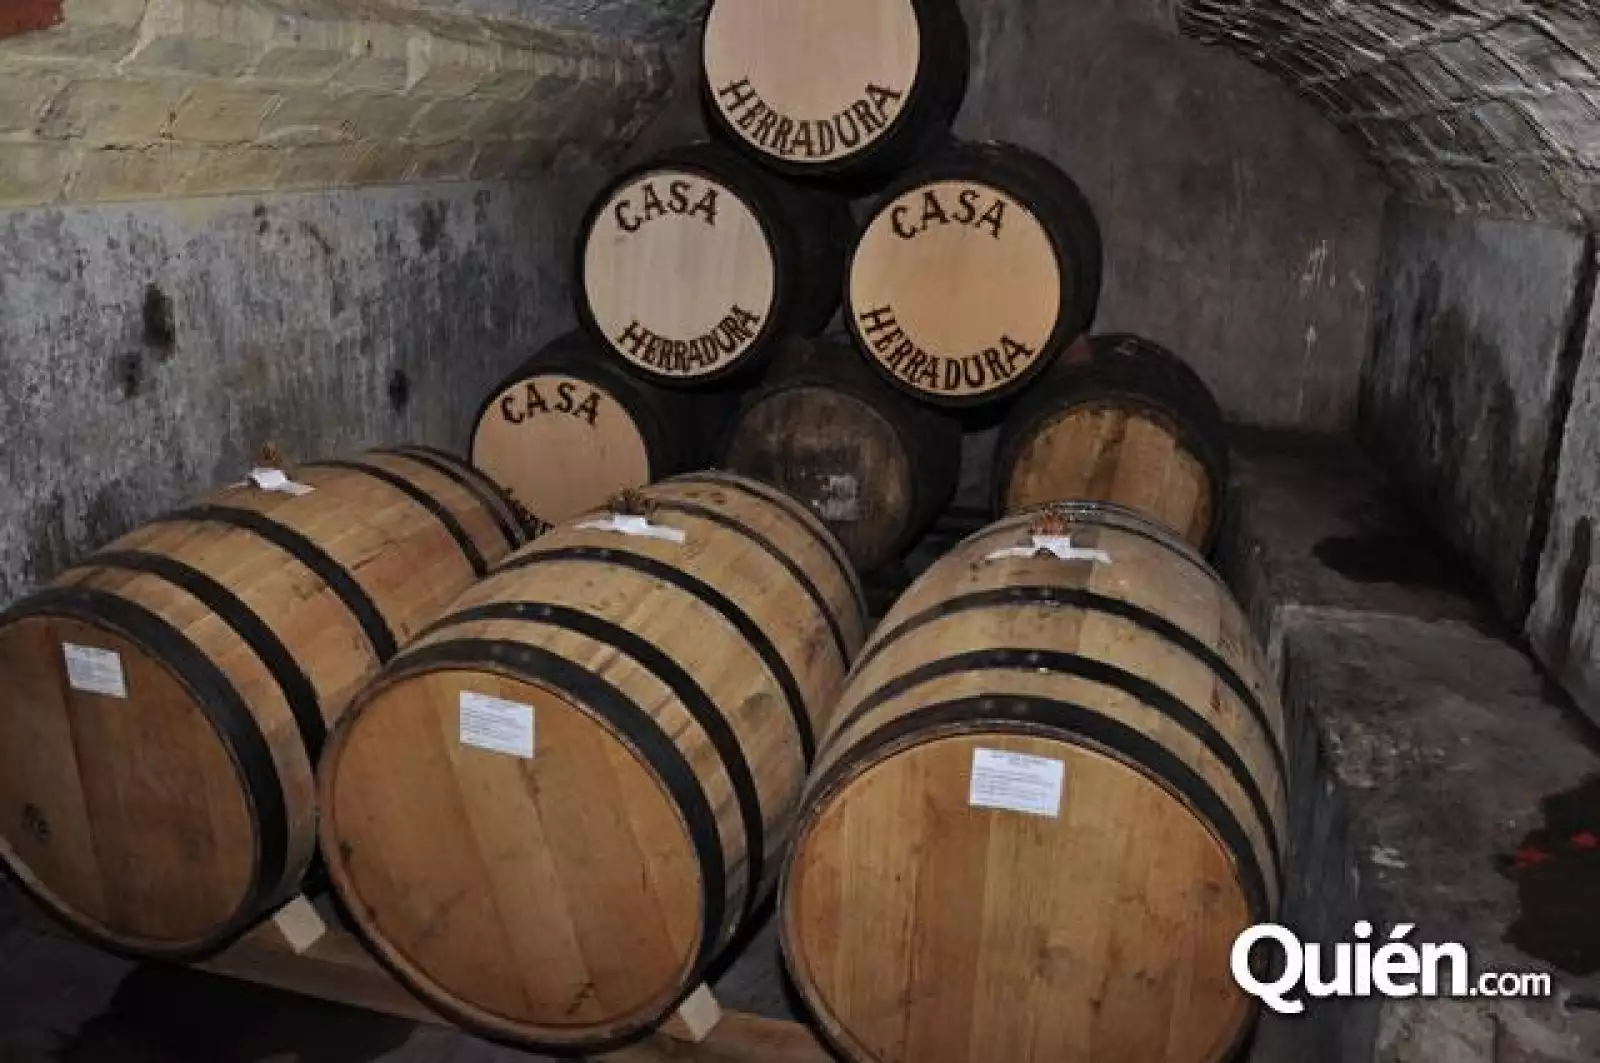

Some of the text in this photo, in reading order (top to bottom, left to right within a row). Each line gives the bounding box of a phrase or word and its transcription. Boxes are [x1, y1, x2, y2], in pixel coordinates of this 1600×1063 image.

[719, 77, 902, 156] HERRADURA
[614, 180, 720, 232] CASA
[891, 189, 1006, 240] CASA
[616, 304, 760, 373] HERRADURA
[860, 304, 1034, 390] HERRADURA
[501, 382, 601, 428] CASA
